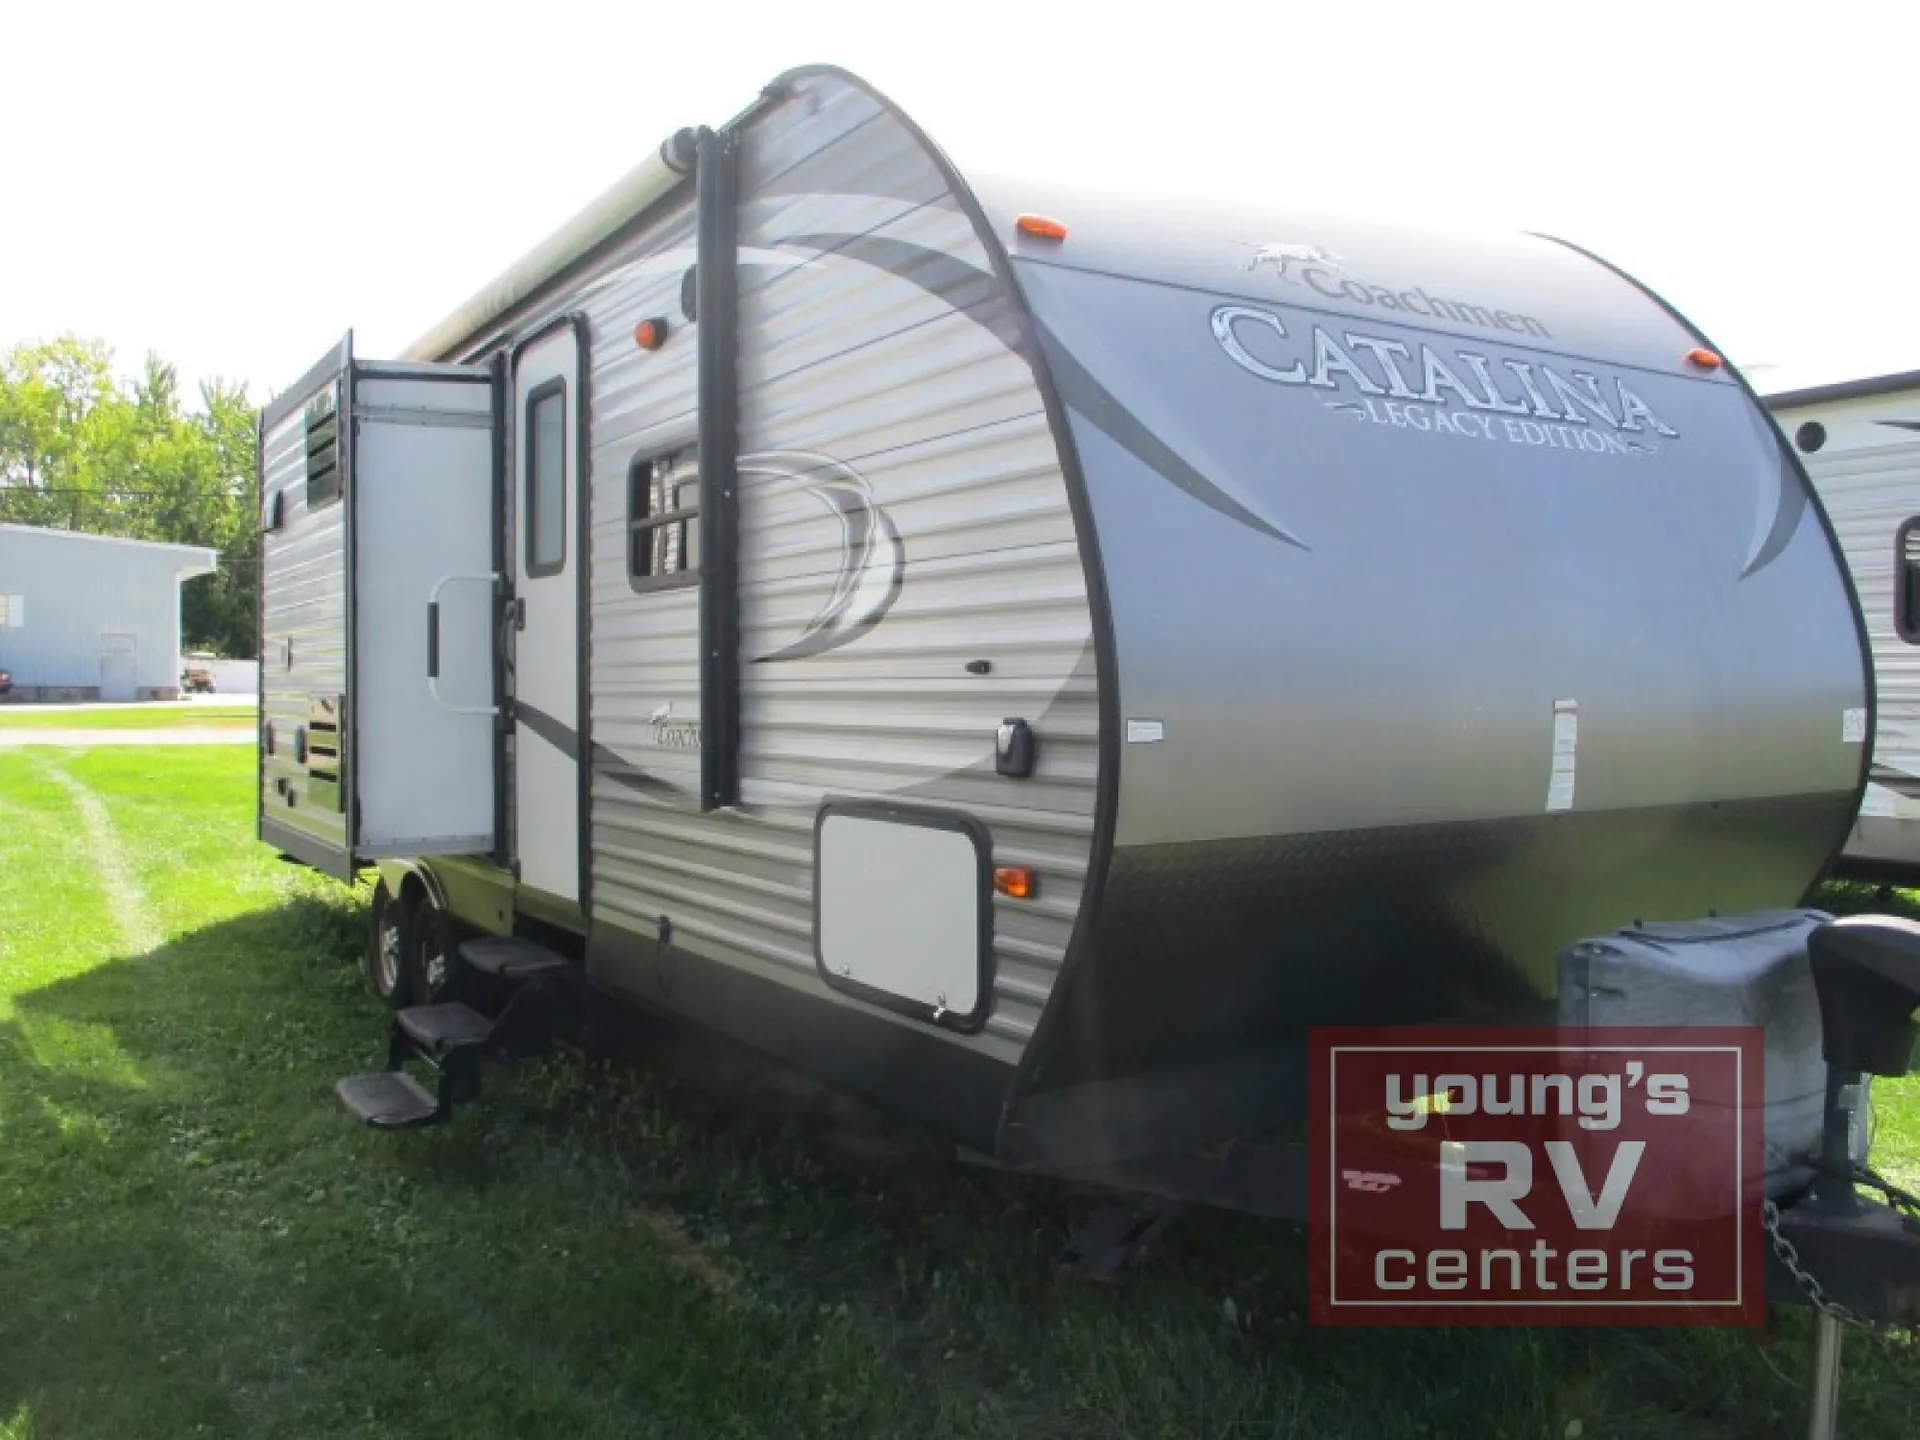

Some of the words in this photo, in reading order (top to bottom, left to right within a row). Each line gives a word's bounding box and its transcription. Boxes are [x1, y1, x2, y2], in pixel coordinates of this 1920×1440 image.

[1300, 268, 1554, 338] Coachmen
[1209, 304, 1680, 439] CATALINA
[1365, 398, 1499, 440] LEGACY
[1504, 419, 1625, 454] EDITION
